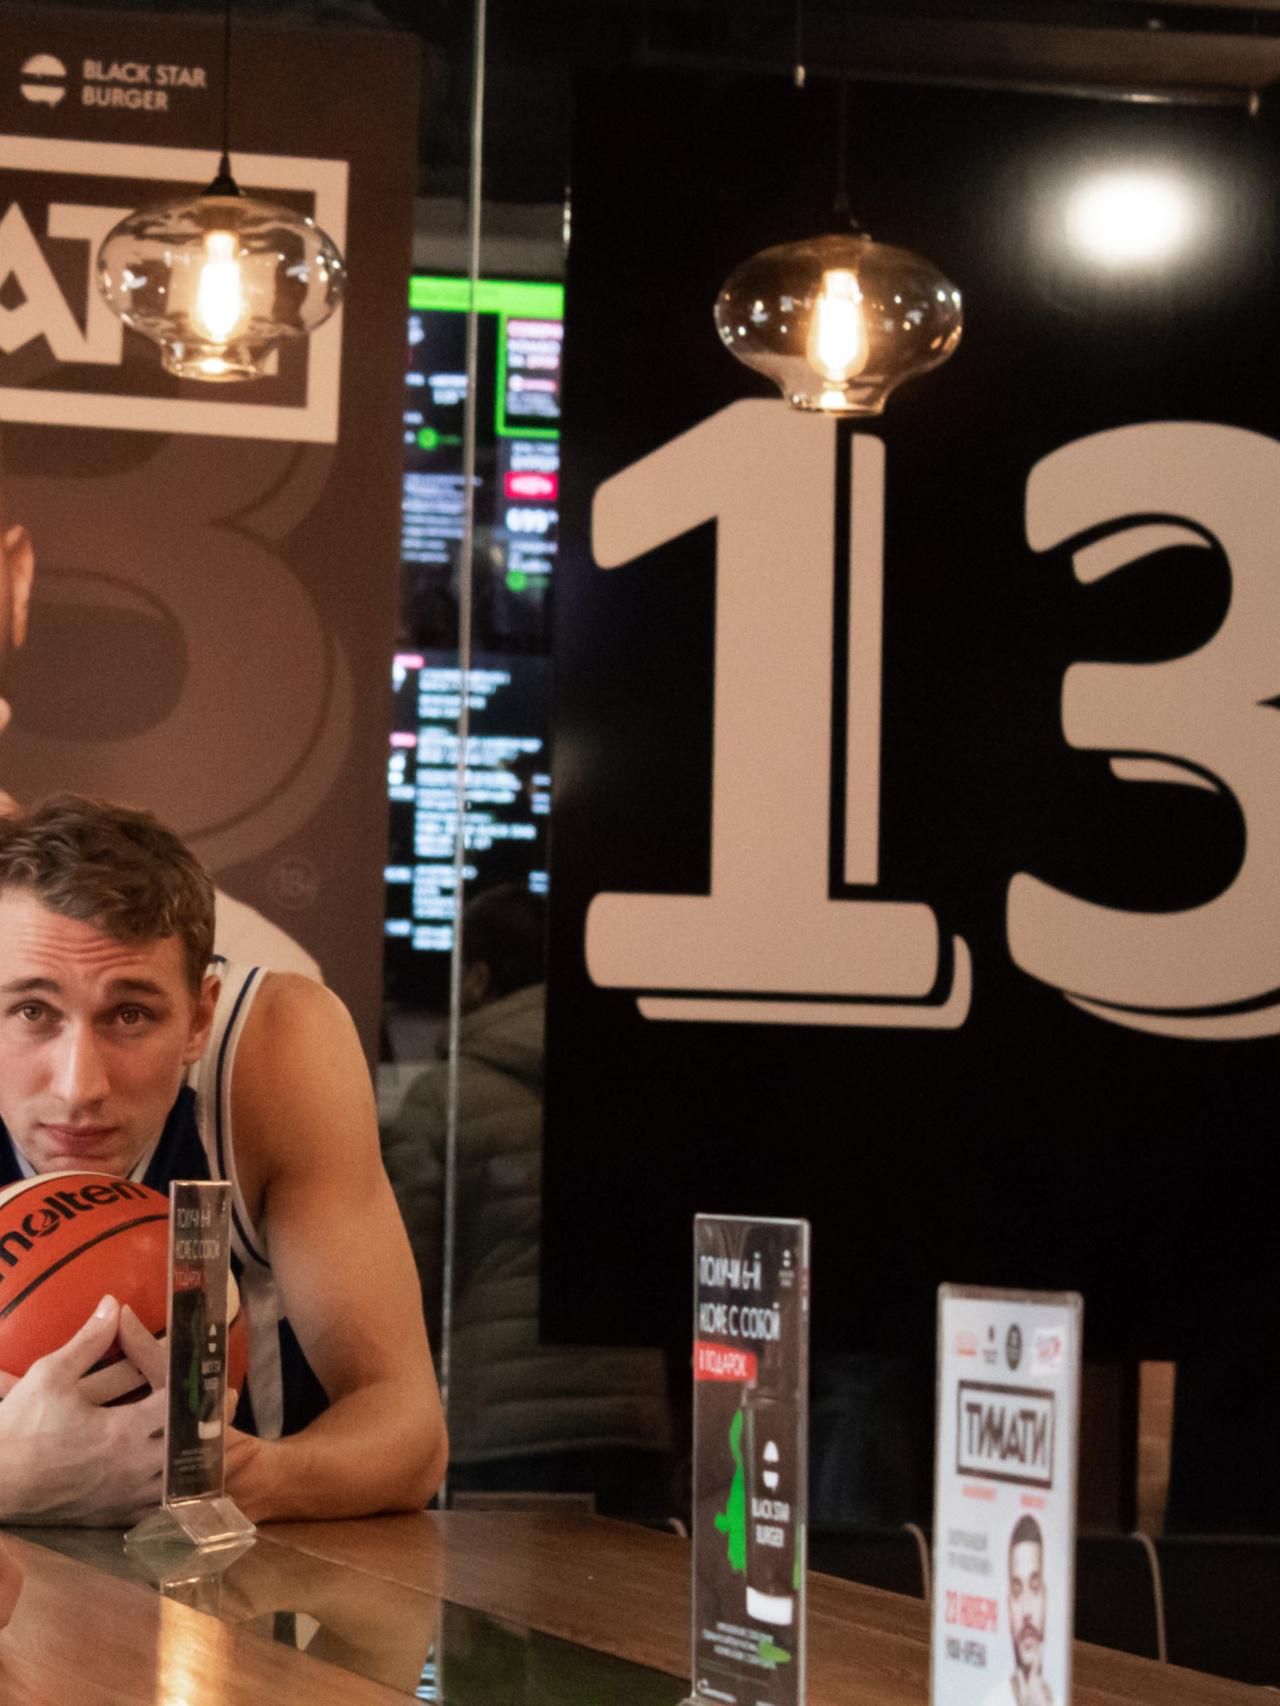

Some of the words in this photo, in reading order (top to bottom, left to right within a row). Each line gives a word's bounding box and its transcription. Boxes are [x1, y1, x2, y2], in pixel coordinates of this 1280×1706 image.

[82, 58, 152, 84] BLACK
[155, 64, 207, 89] STAR
[81, 85, 169, 111] BURGER
[584, 397, 1280, 1042] 13
[964, 1402, 1048, 1466] ТИМАТИ
